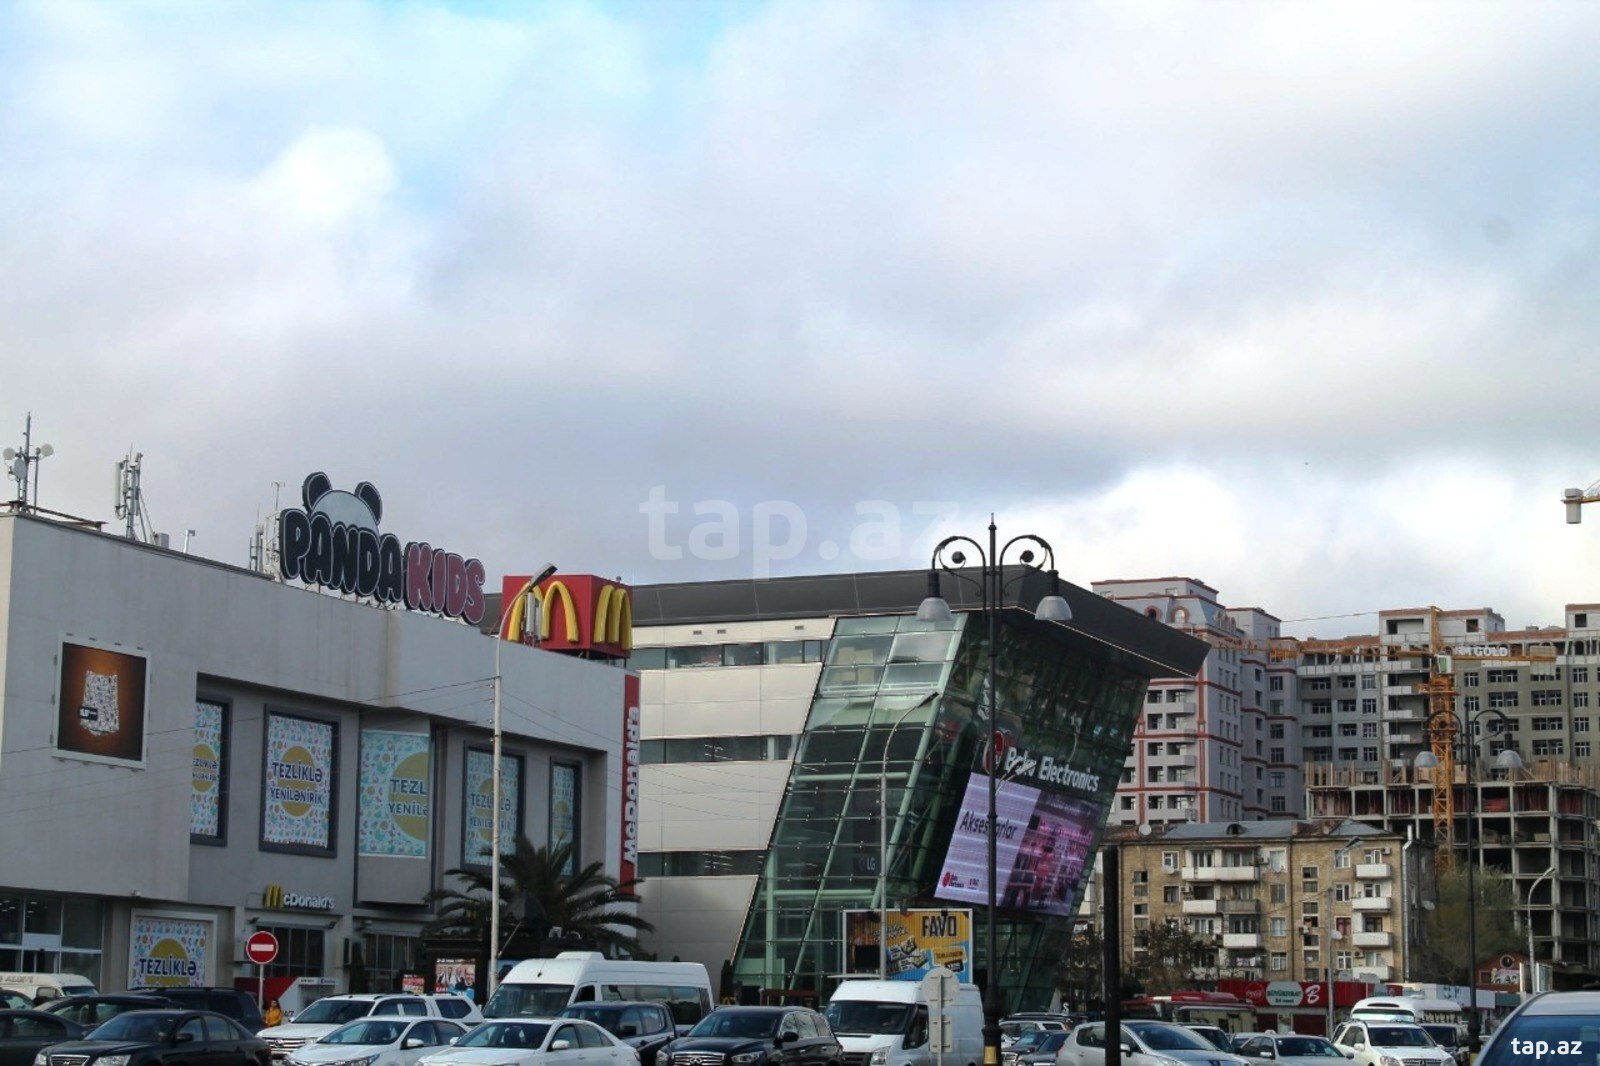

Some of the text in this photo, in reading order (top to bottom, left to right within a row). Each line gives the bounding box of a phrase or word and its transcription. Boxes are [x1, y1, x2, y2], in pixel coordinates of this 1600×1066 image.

[280, 508, 485, 625] PANDA KIDS
[271, 759, 324, 783] TEZLİKLƏ
[1037, 755, 1100, 793] Electronics
[921, 915, 957, 937] FAVO
[139, 955, 197, 977] TEZLİKLƏ
